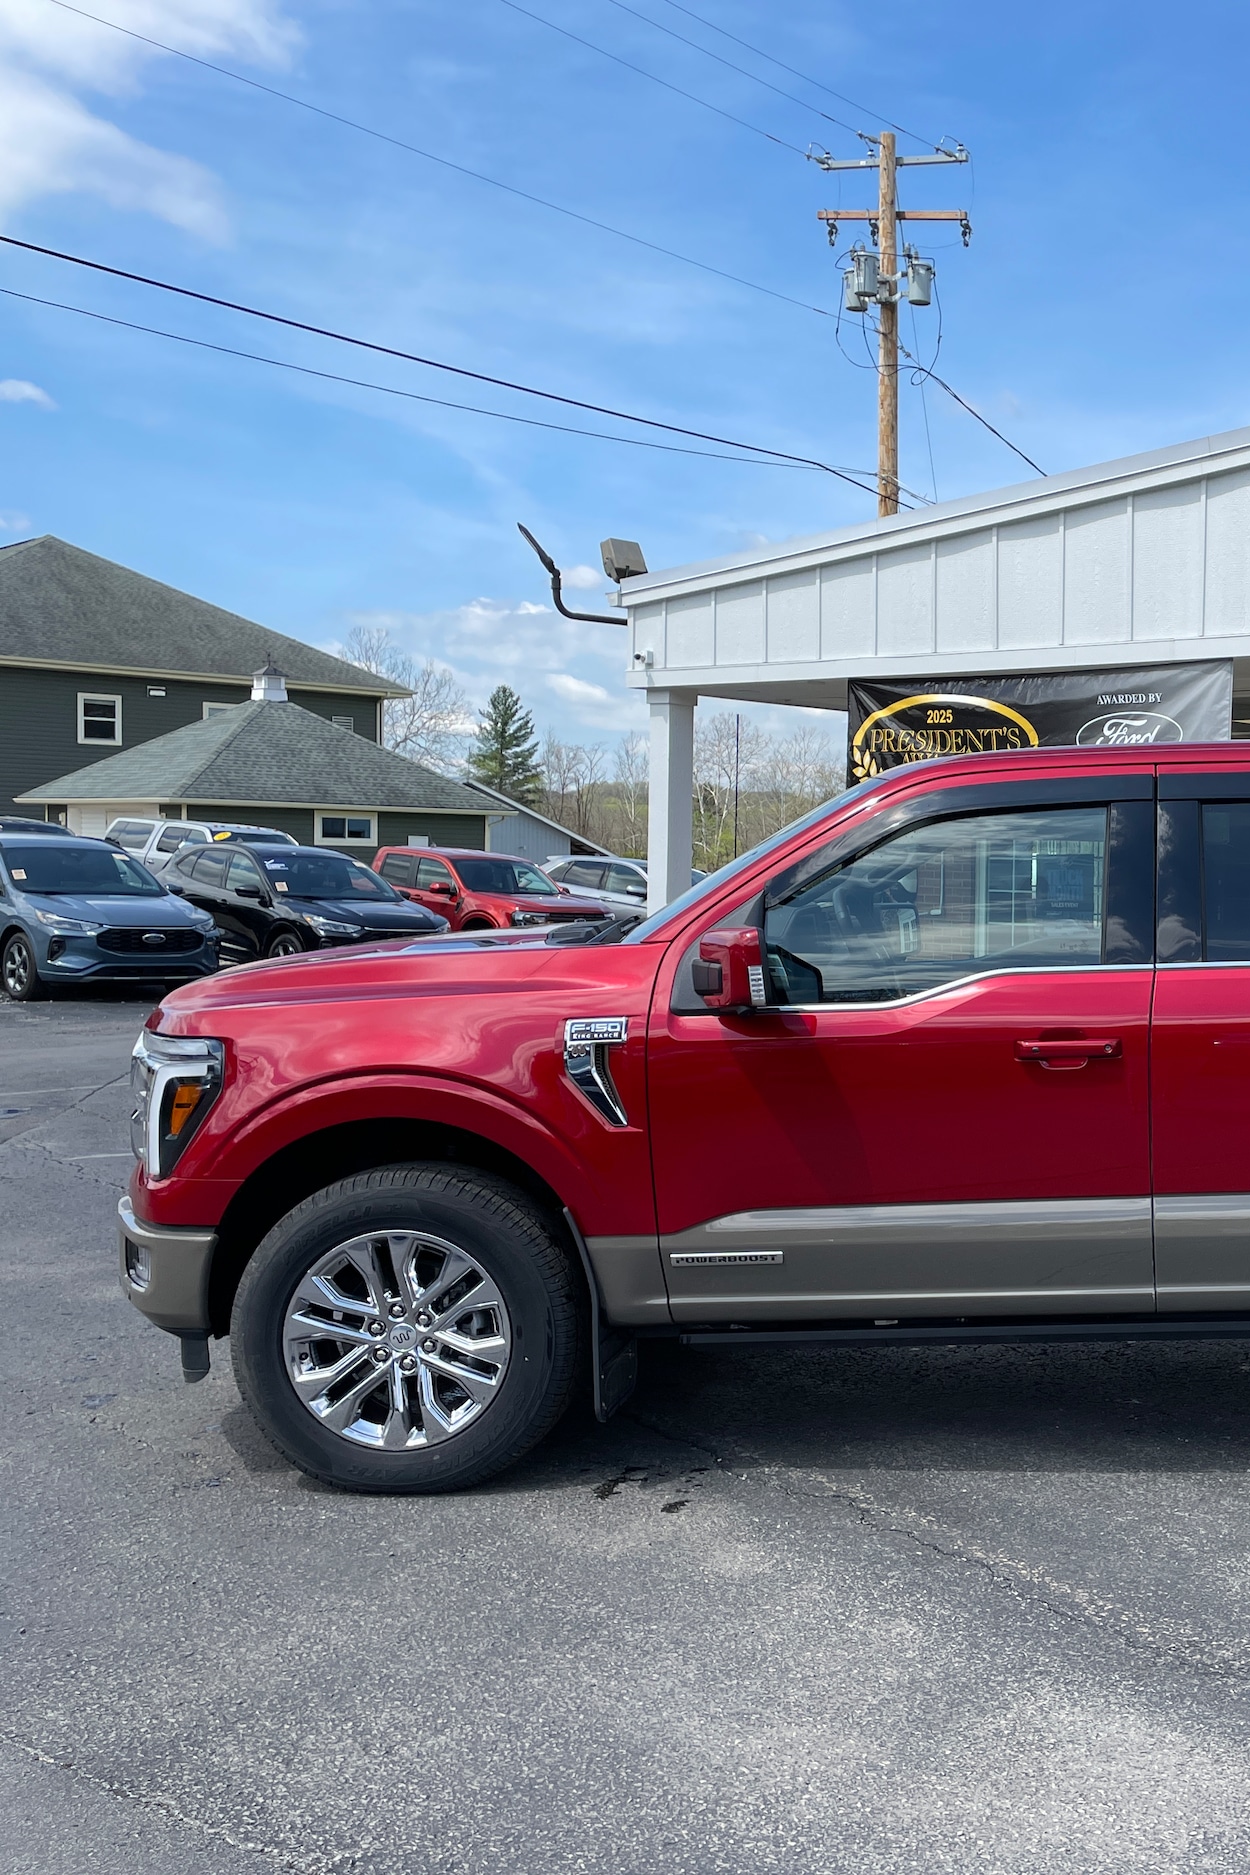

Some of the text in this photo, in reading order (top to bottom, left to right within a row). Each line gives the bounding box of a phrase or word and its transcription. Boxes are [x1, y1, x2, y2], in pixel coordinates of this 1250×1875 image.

[1096, 692, 1163, 705] AWARDED BY
[926, 709, 954, 724] 2025
[869, 726, 1022, 753] PRESIDENT'S
[1095, 718, 1161, 746] Ford
[571, 1022, 621, 1033] F-150
[283, 1205, 372, 1267] PIRELLI
[675, 1255, 776, 1264] POWERBOOST
